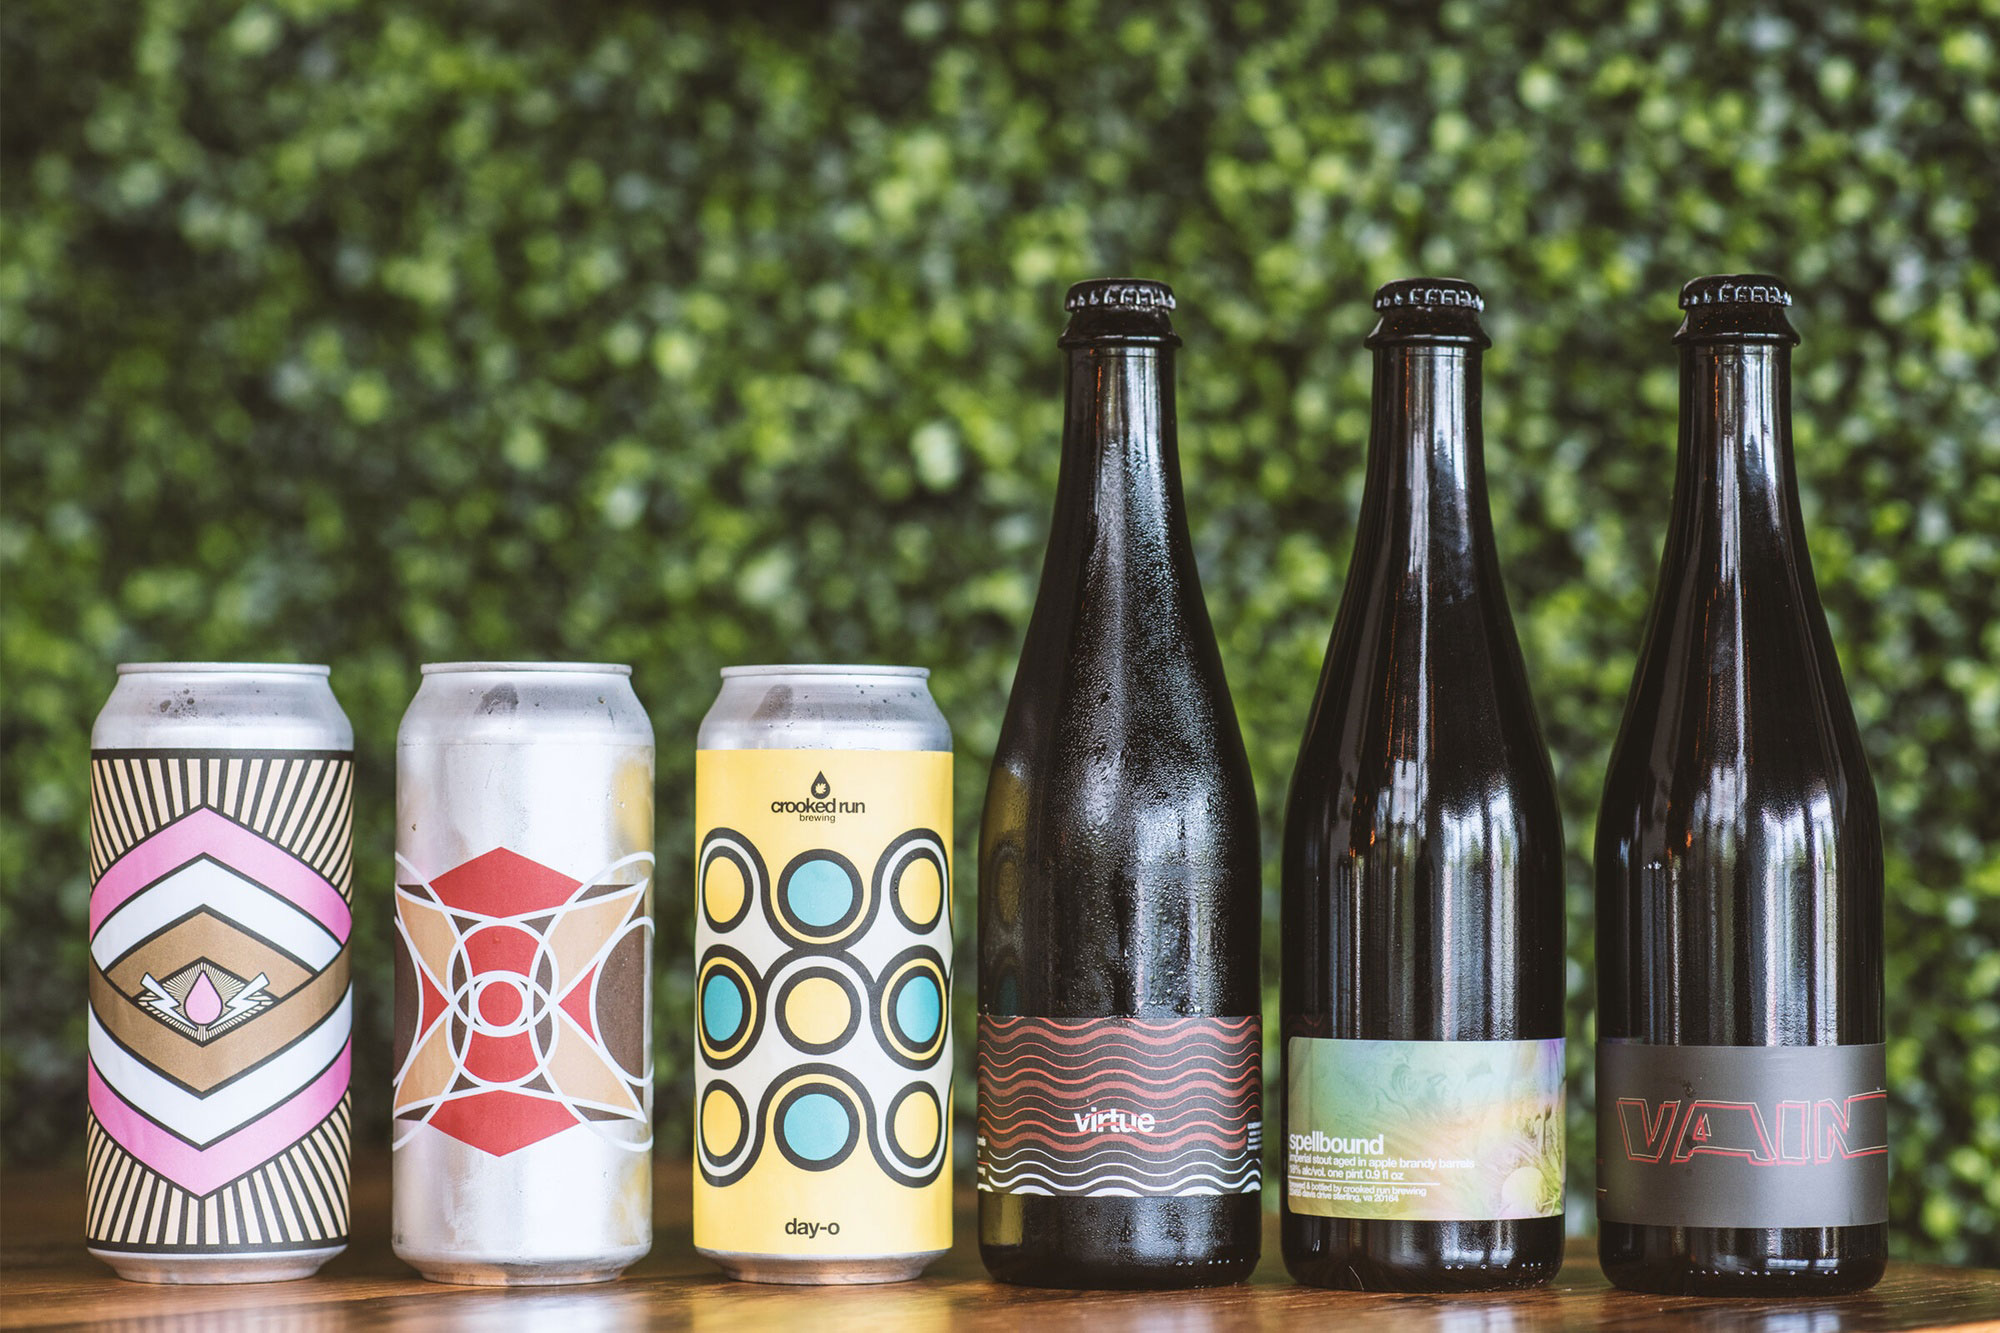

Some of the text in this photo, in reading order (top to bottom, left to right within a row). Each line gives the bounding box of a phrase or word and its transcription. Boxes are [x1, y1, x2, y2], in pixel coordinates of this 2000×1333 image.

[771, 797, 866, 813] crooked run
[799, 814, 836, 824] brewing
[1074, 1107, 1156, 1133] virtue
[1616, 1090, 1887, 1166] VAIN
[1289, 1131, 1384, 1155] spellbound
[1313, 1155, 1332, 1165] stout
[1333, 1156, 1356, 1168] aged
[1357, 1156, 1367, 1167] in
[1368, 1158, 1397, 1169] apple
[1400, 1158, 1437, 1170] brandy
[1438, 1158, 1475, 1169] barrels
[1327, 1169, 1344, 1178] one
[1345, 1169, 1364, 1180] pint
[1365, 1169, 1380, 1179] 0.9
[1391, 1171, 1404, 1180] oz
[1333, 1184, 1342, 1195] by
[1343, 1185, 1375, 1194] crooked
[1391, 1186, 1427, 1197] brewing
[785, 1217, 840, 1239] day-o
